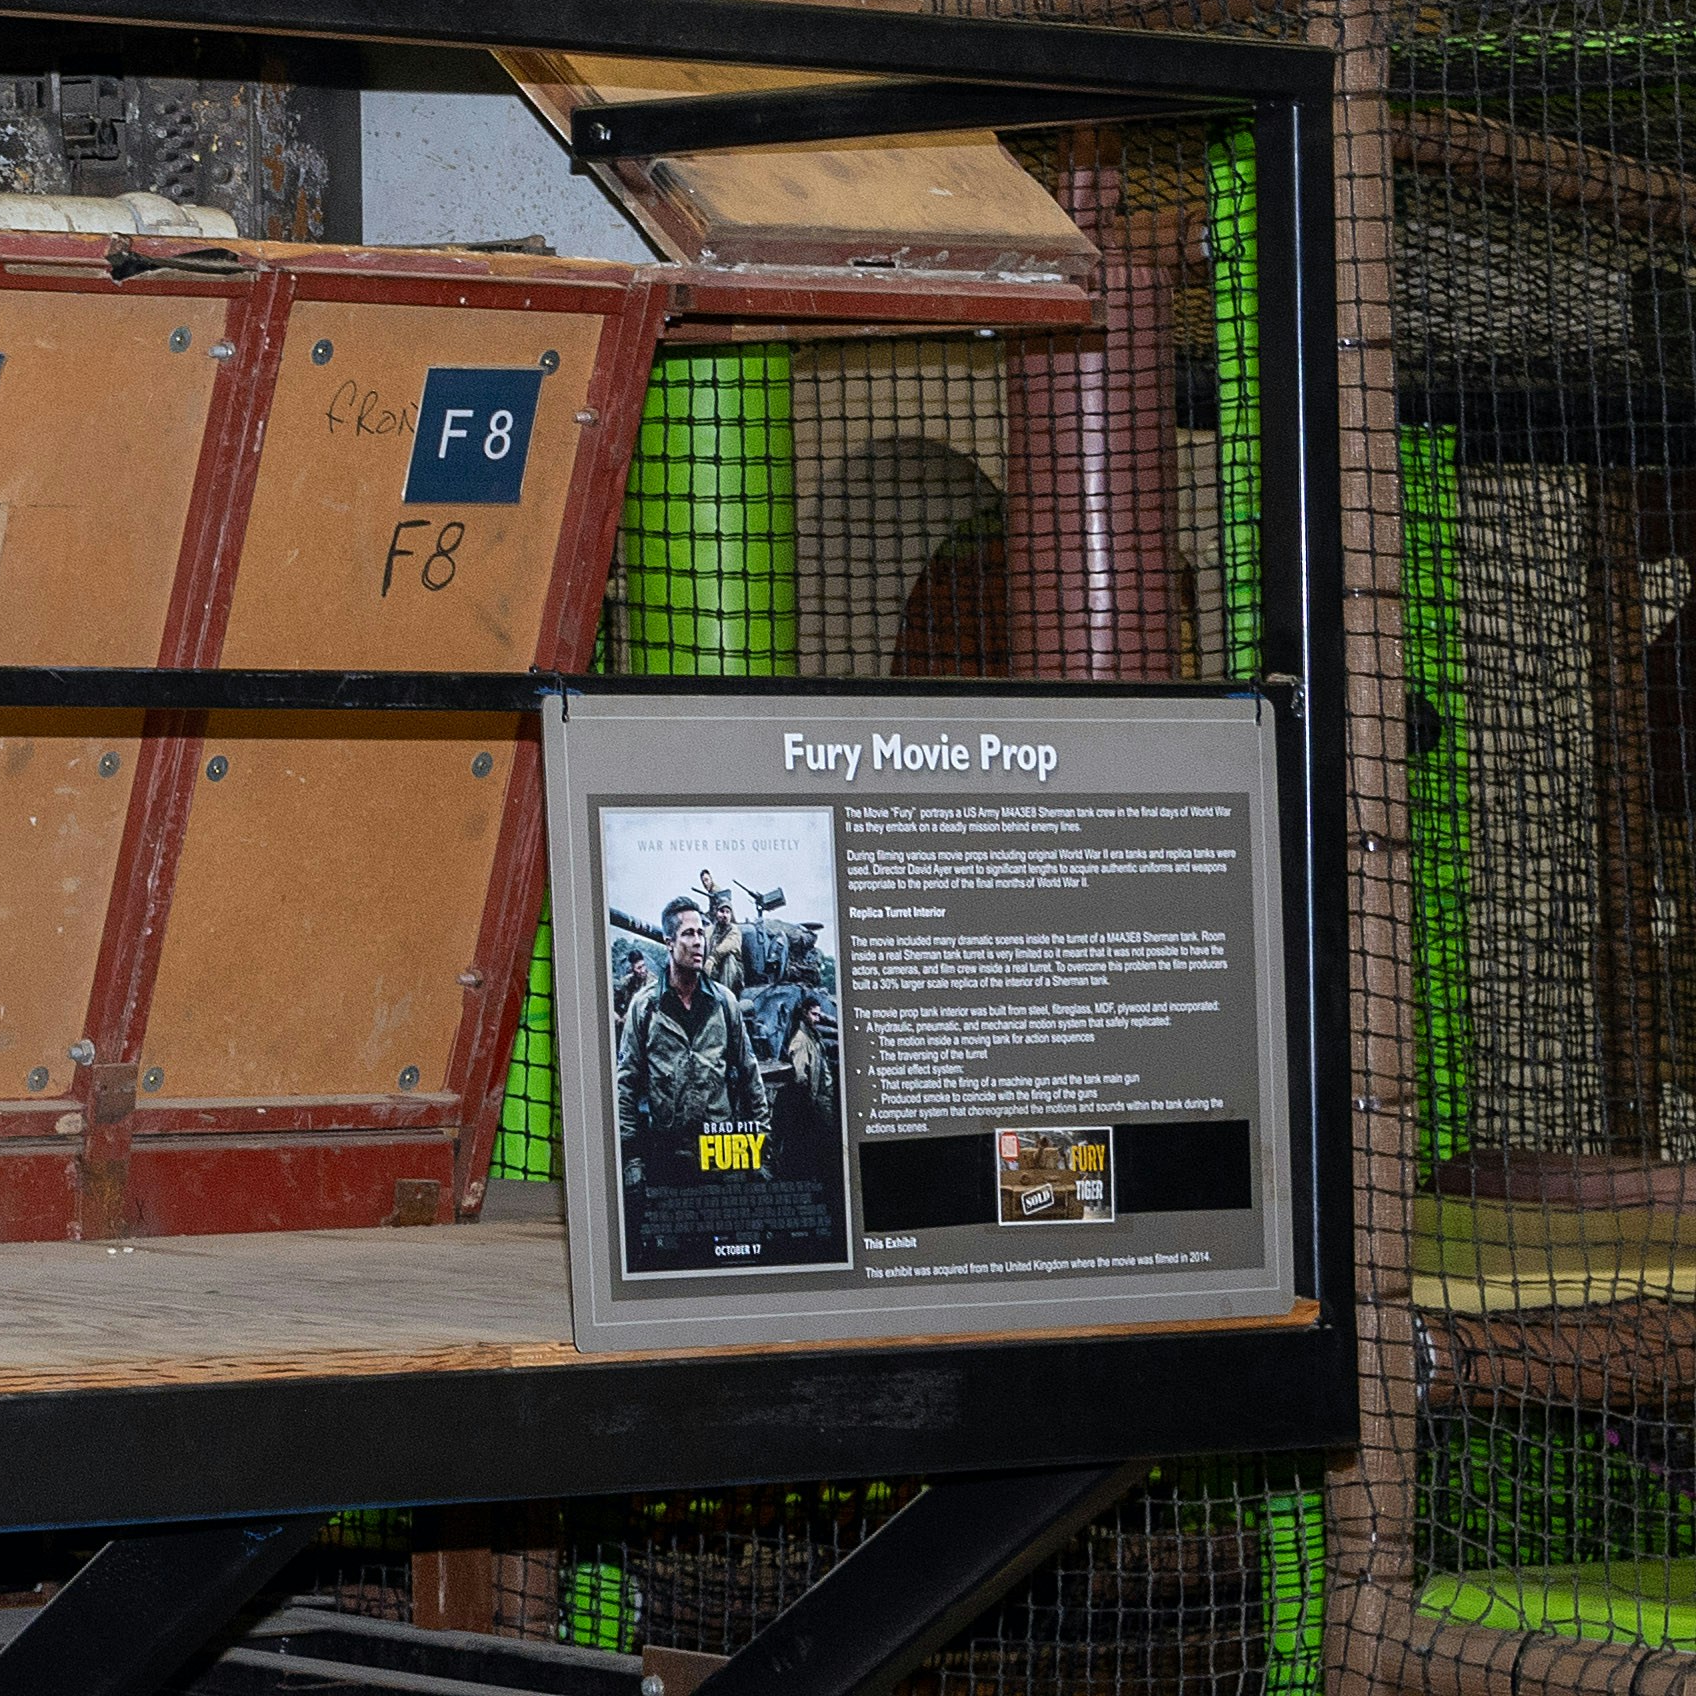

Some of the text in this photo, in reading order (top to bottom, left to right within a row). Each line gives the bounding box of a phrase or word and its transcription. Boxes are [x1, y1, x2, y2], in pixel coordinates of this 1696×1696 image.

[381, 519, 466, 598] F8
[784, 732, 1058, 782] Fury Movie Prop
[637, 838, 800, 852] WAR NEVER ENDS QUIETLY
[850, 906, 946, 921] Replica Turret Interior
[703, 1120, 761, 1134] BRAD PITT
[698, 1133, 766, 1172] FURY
[1071, 1144, 1106, 1172] FURY
[1025, 1190, 1051, 1209] SOLD
[1075, 1180, 1104, 1200] TIGER
[714, 1243, 761, 1257] OCTOBER 17
[864, 1237, 916, 1249] This Exhibit
